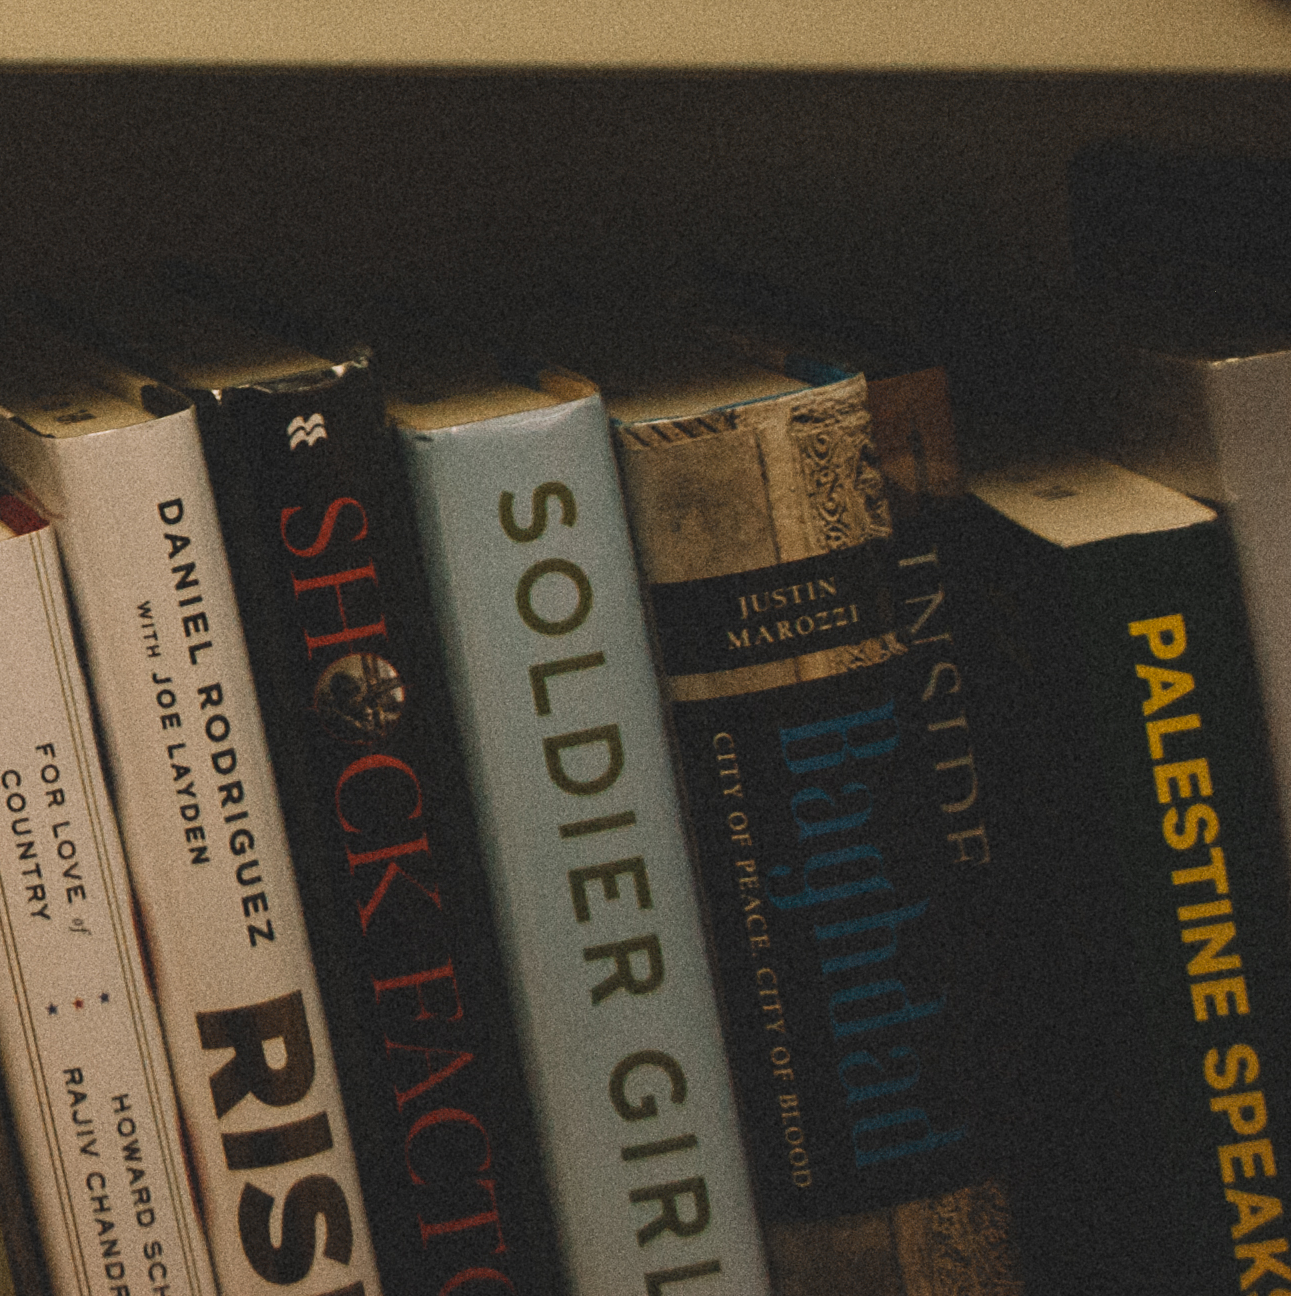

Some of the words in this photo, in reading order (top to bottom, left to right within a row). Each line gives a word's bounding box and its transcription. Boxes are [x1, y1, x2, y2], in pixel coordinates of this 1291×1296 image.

[726, 605, 860, 651] MAROZZI
[739, 577, 838, 620] JUSTIN
[151, 672, 183, 733] JOE
[157, 498, 215, 665] DANIEL
[197, 682, 276, 948] RODRIGUEZ
[499, 481, 665, 1005] SOLDIER
[897, 550, 992, 866] INSIDE
[1, 769, 51, 923] COUNTRY
[35, 742, 67, 809] FOR
[52, 817, 87, 904] LOVE
[166, 743, 210, 866] LAYDEN
[1127, 613, 1251, 1023] PALESTINE
[63, 1067, 101, 1159] RAJIV
[111, 1094, 158, 1229] HOWARD
